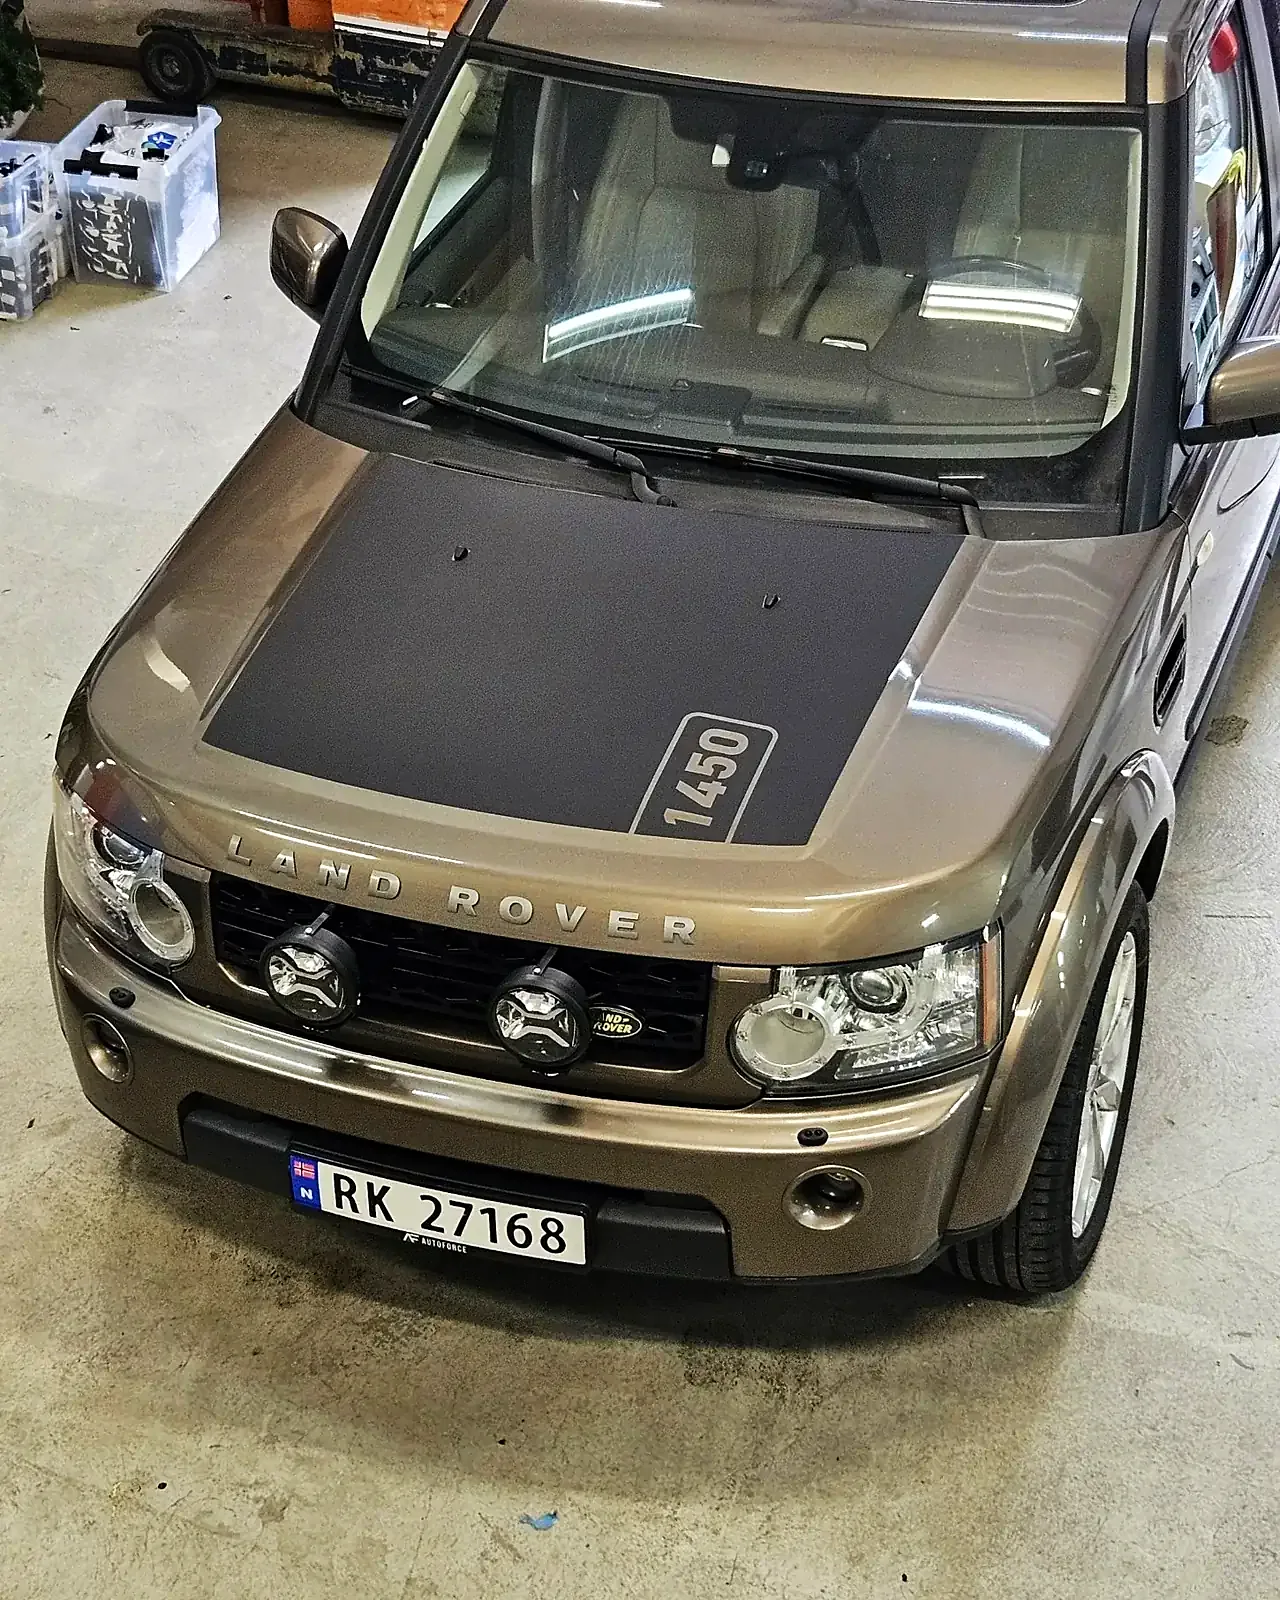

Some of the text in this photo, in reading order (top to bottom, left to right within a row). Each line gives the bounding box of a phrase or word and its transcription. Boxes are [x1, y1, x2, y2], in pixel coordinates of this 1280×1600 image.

[663, 728, 749, 827] 1450
[226, 835, 697, 946] LAND ROVER
[300, 1187, 314, 1201] N
[333, 1173, 567, 1255] RK 27168
[421, 1237, 468, 1254] AUTOFORCE
